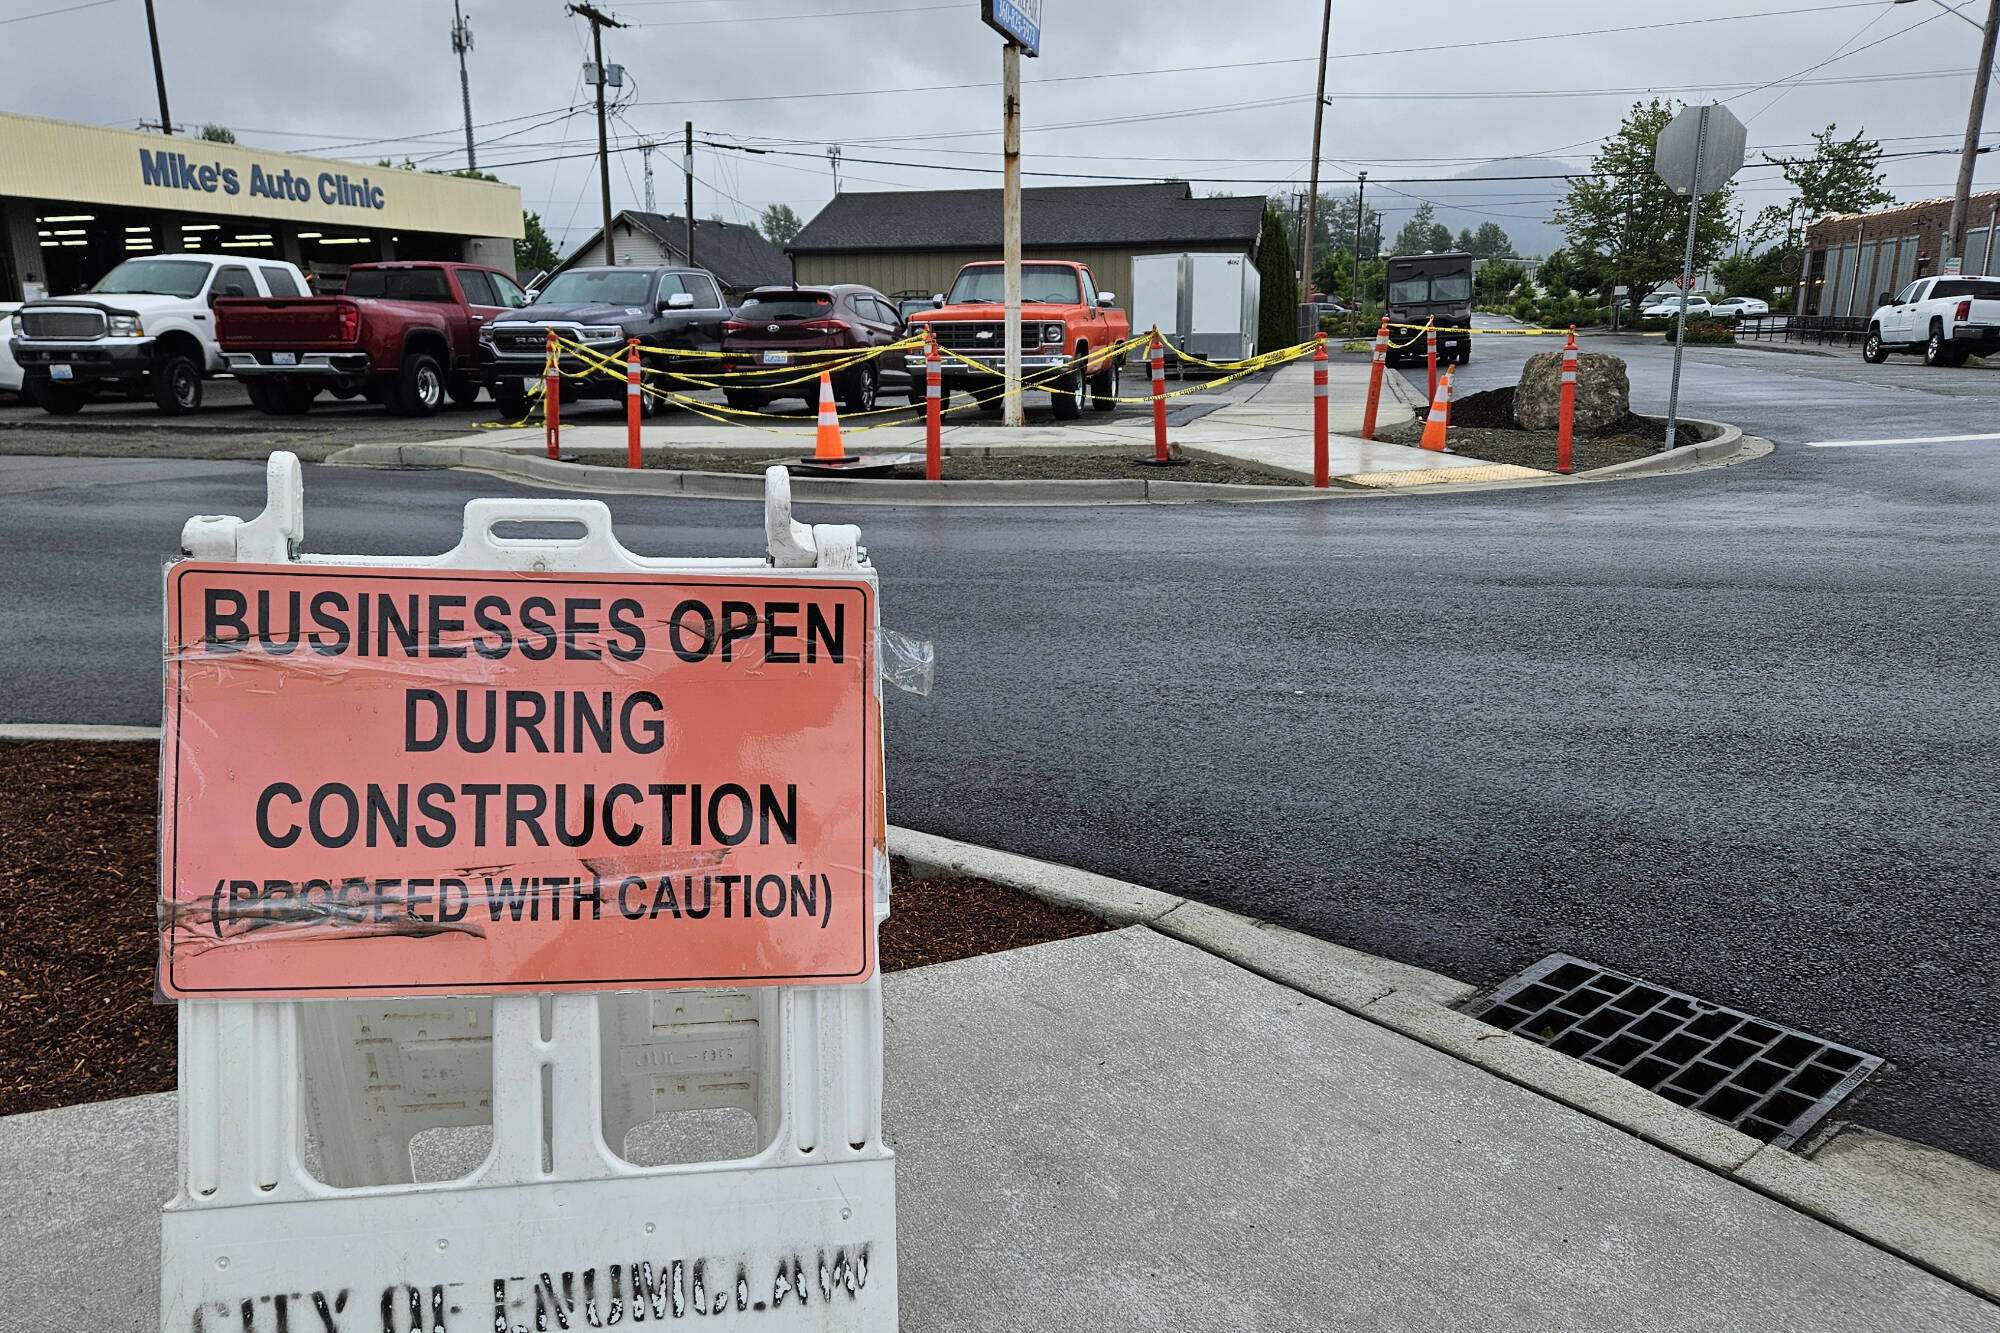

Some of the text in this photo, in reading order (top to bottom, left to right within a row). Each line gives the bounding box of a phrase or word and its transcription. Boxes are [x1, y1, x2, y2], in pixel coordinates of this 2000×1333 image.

[139, 148, 385, 210] Mike's Auto Clinic
[1677, 278, 1695, 287] SP
[203, 587, 845, 664] BUSINESSES OPEN
[404, 688, 665, 755] DURING
[255, 781, 798, 849] CONSTRUCTION
[484, 874, 602, 923] WITH
[617, 872, 833, 930] CAUTION)
[380, 1282, 465, 1333] OF
[492, 1240, 875, 1333] ENUMCLAW
